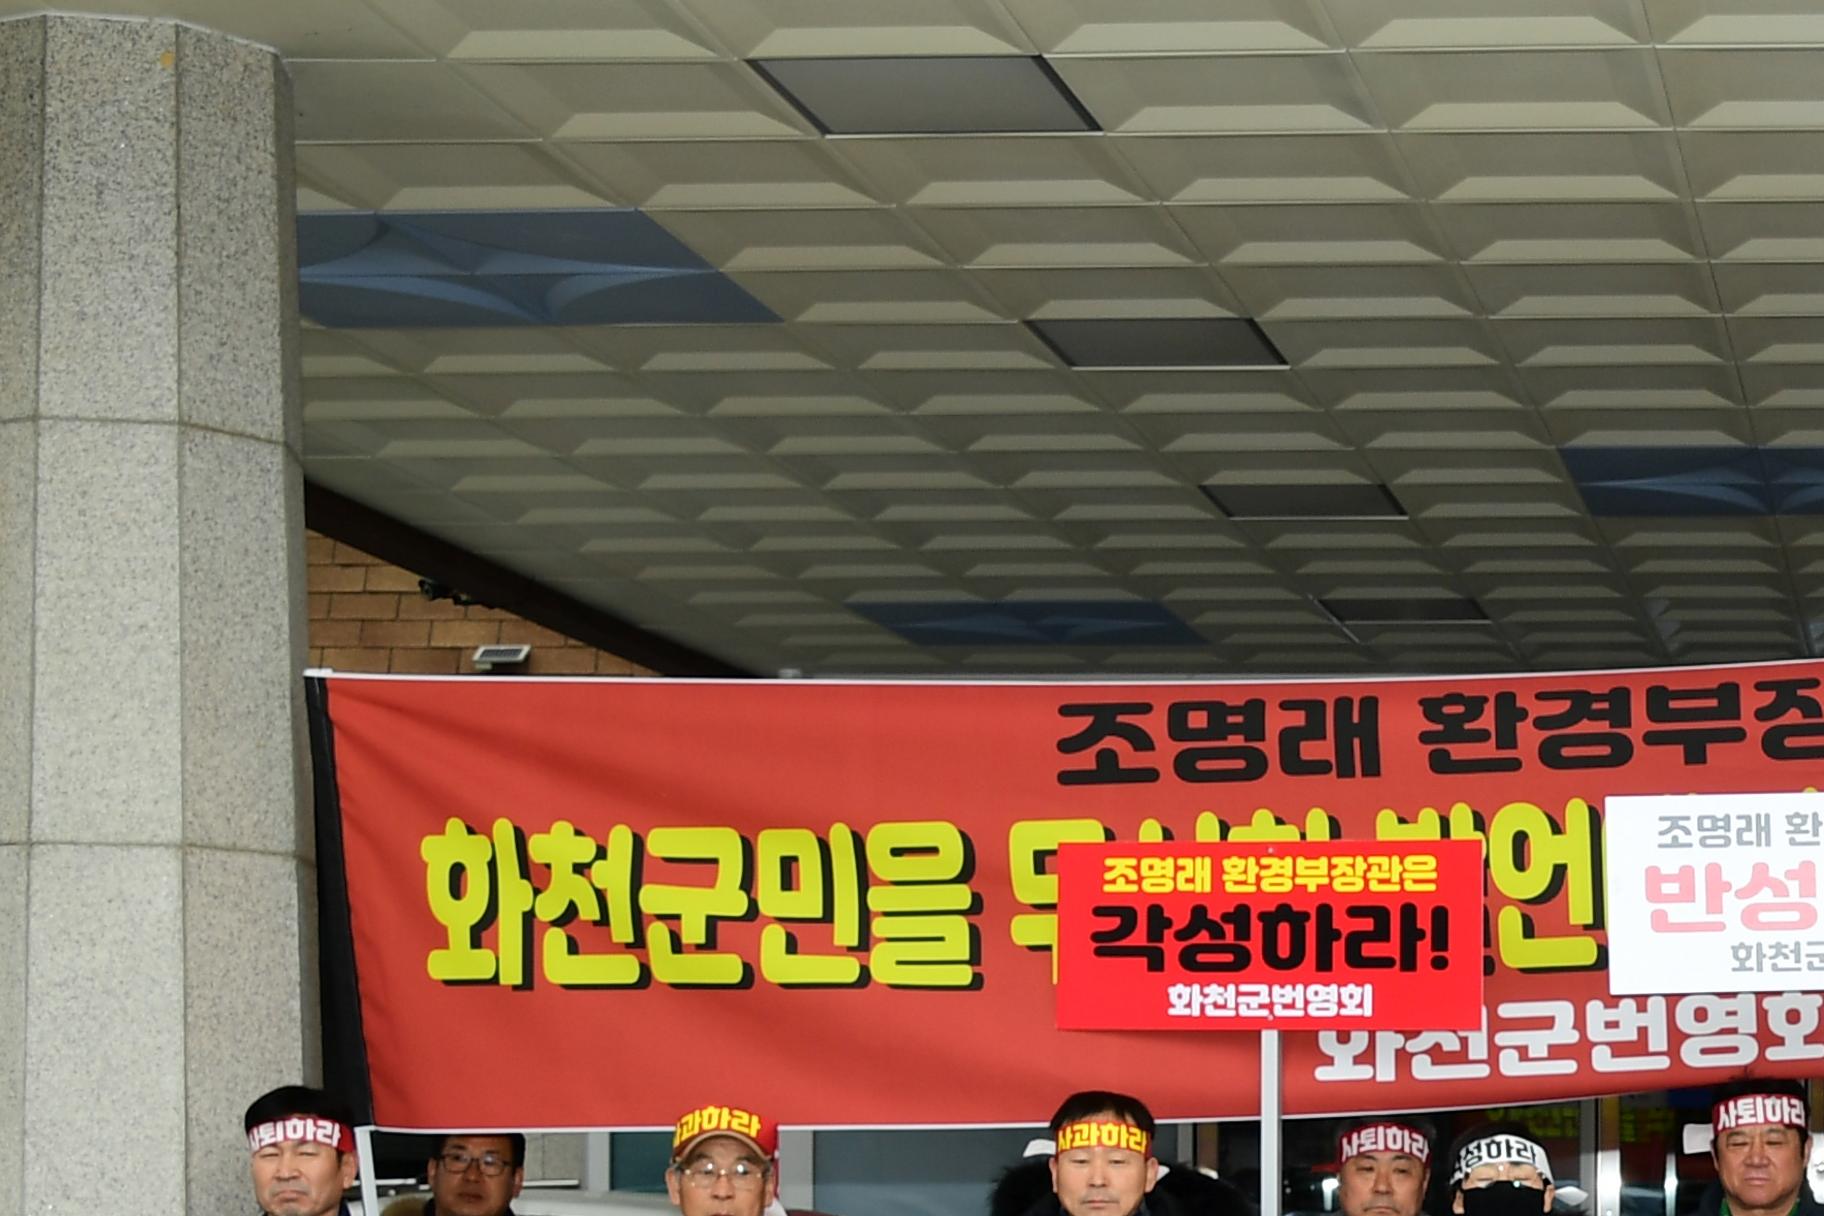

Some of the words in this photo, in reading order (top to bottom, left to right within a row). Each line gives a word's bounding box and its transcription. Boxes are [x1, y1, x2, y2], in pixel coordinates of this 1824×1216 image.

[1056, 695, 1381, 786] 조명래
[1657, 812, 1773, 849] 조명래
[1103, 856, 1212, 893] 조명래
[1222, 855, 1438, 893] 환경부장관은
[420, 817, 973, 985] 화천군민을
[1092, 903, 1449, 972] 각성하라!
[1168, 983, 1373, 1017] 화천군번영회
[1717, 1096, 1806, 1131] 사퇴하라
[1058, 1121, 1147, 1154] 사과하라
[1340, 1125, 1429, 1164] 사퇴하라
